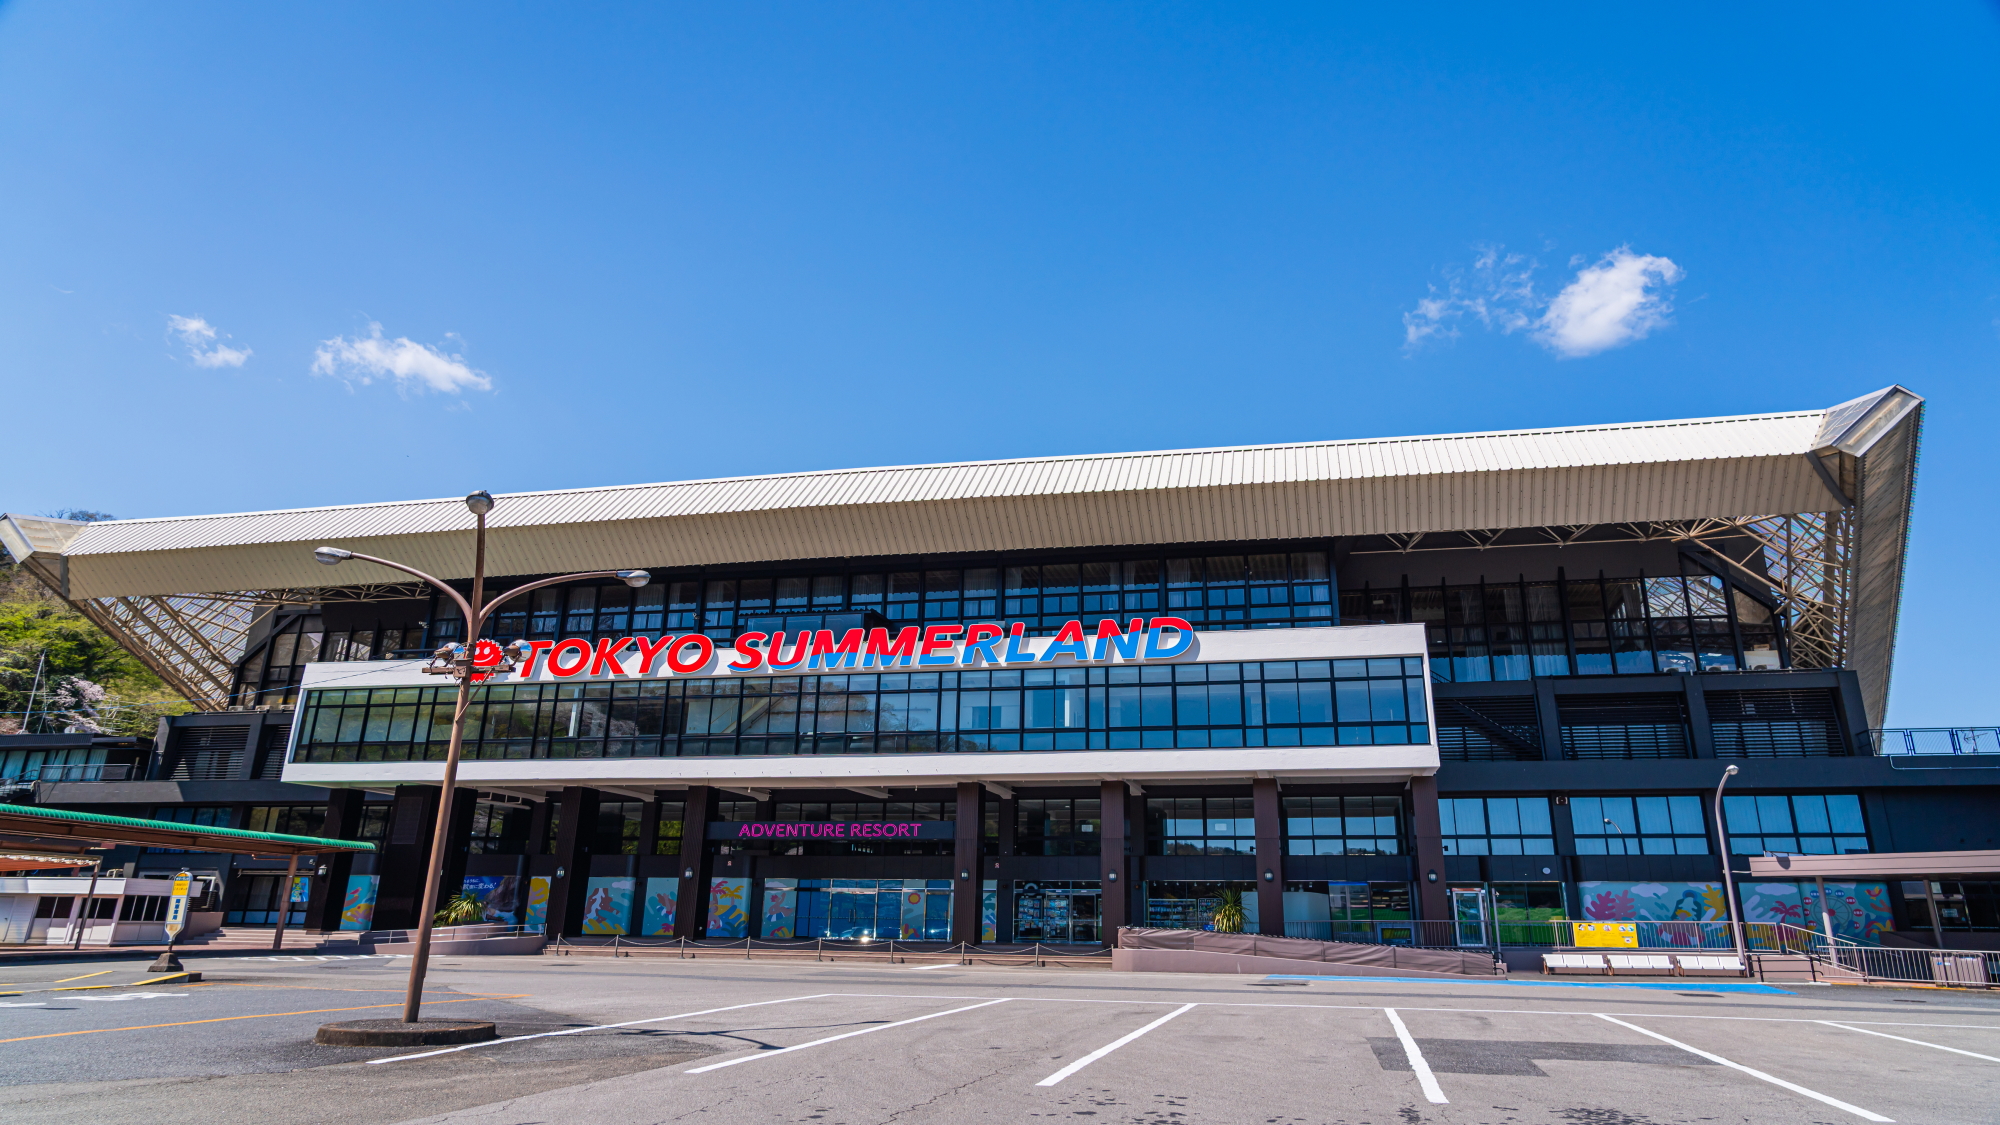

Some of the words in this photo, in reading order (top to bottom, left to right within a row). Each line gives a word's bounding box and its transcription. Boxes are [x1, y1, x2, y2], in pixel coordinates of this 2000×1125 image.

[520, 634, 714, 678] TOKYO
[727, 617, 1194, 673] SUMMERLAND
[738, 823, 845, 838] ADVENTURE
[850, 823, 922, 838] RESORT
